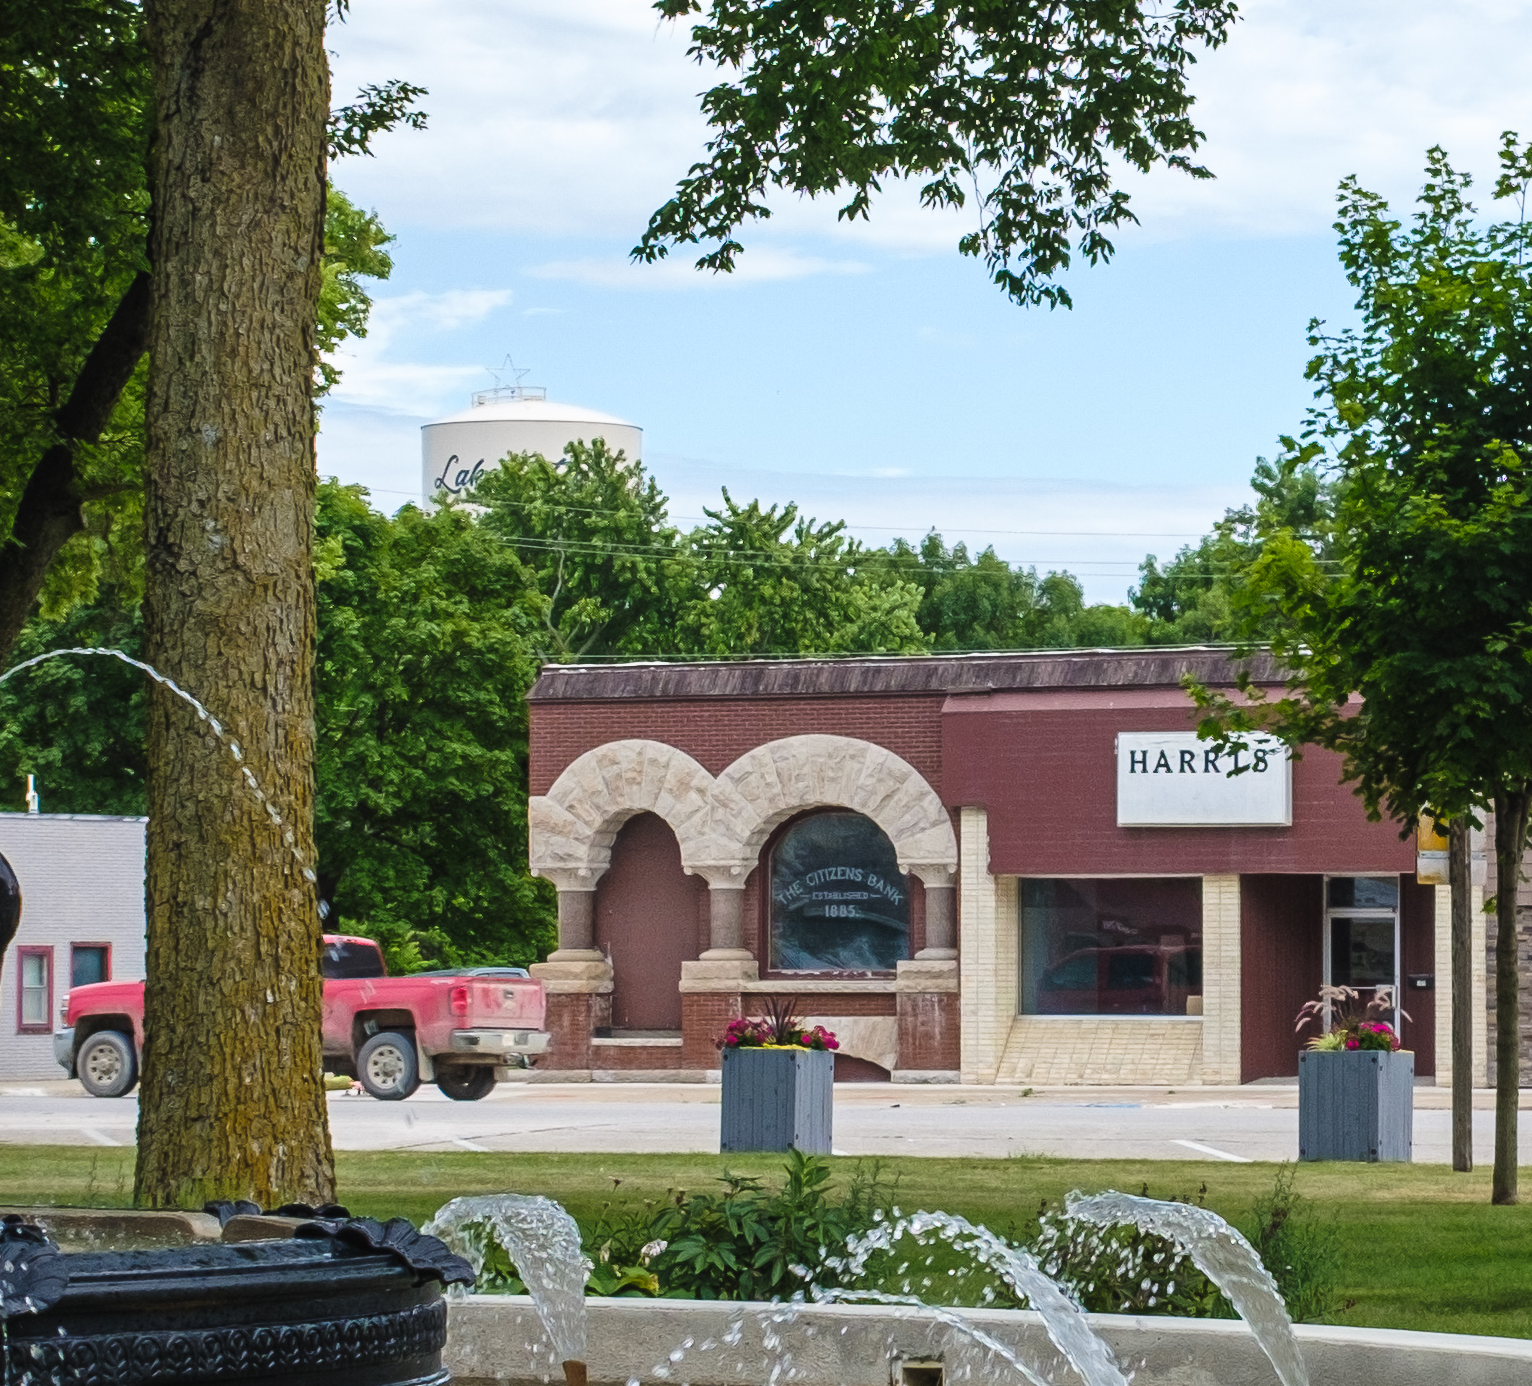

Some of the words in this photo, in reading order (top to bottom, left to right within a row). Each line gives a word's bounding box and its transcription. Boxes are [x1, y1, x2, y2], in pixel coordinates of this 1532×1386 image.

[434, 454, 484, 494] Lak
[776, 880, 804, 905] THE
[805, 866, 864, 886] CITIZENS
[867, 873, 904, 906] BANK
